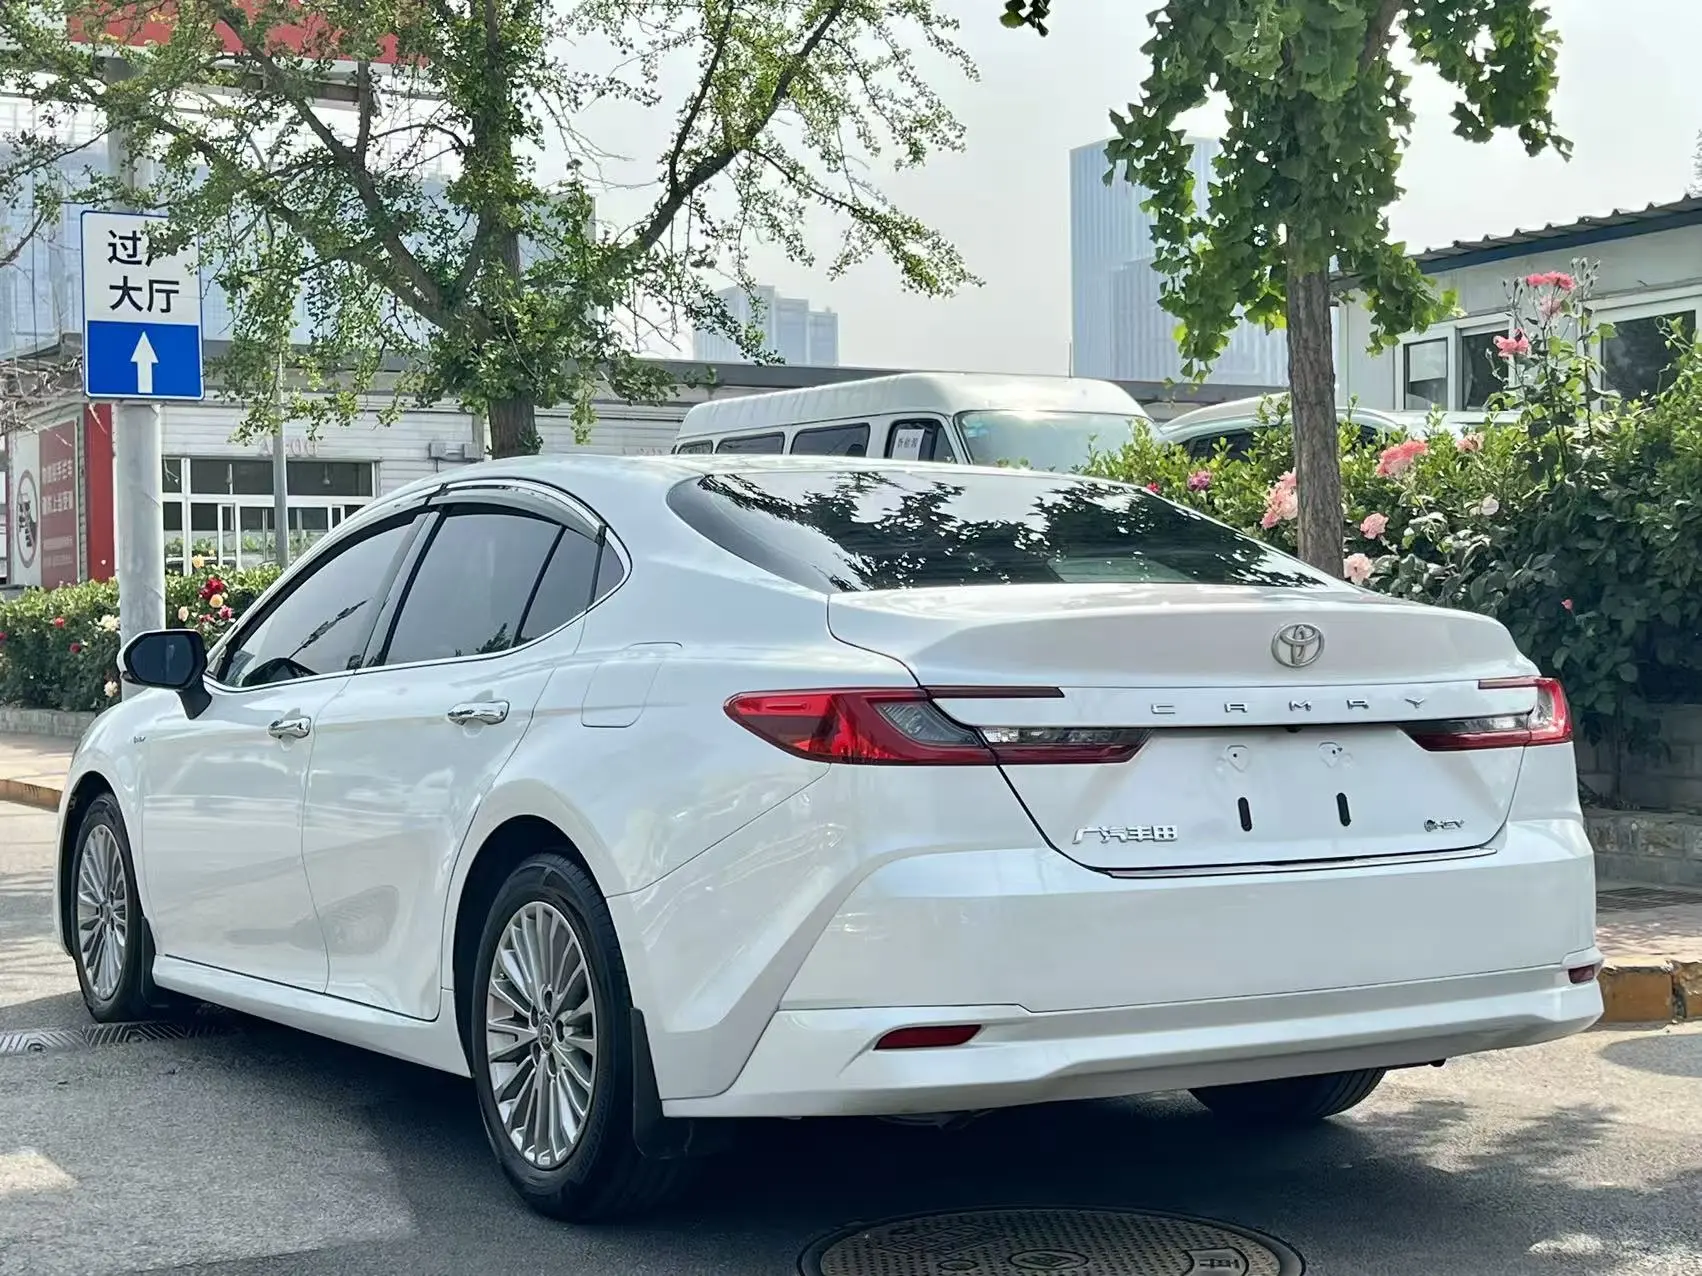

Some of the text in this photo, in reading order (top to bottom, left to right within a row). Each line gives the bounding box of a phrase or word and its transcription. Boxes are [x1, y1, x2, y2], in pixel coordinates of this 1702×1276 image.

[107, 229, 162, 267] 过
[109, 275, 180, 313] 大厅
[1150, 697, 1425, 715] CAMRY
[1072, 825, 1178, 845] 广汽丰田
